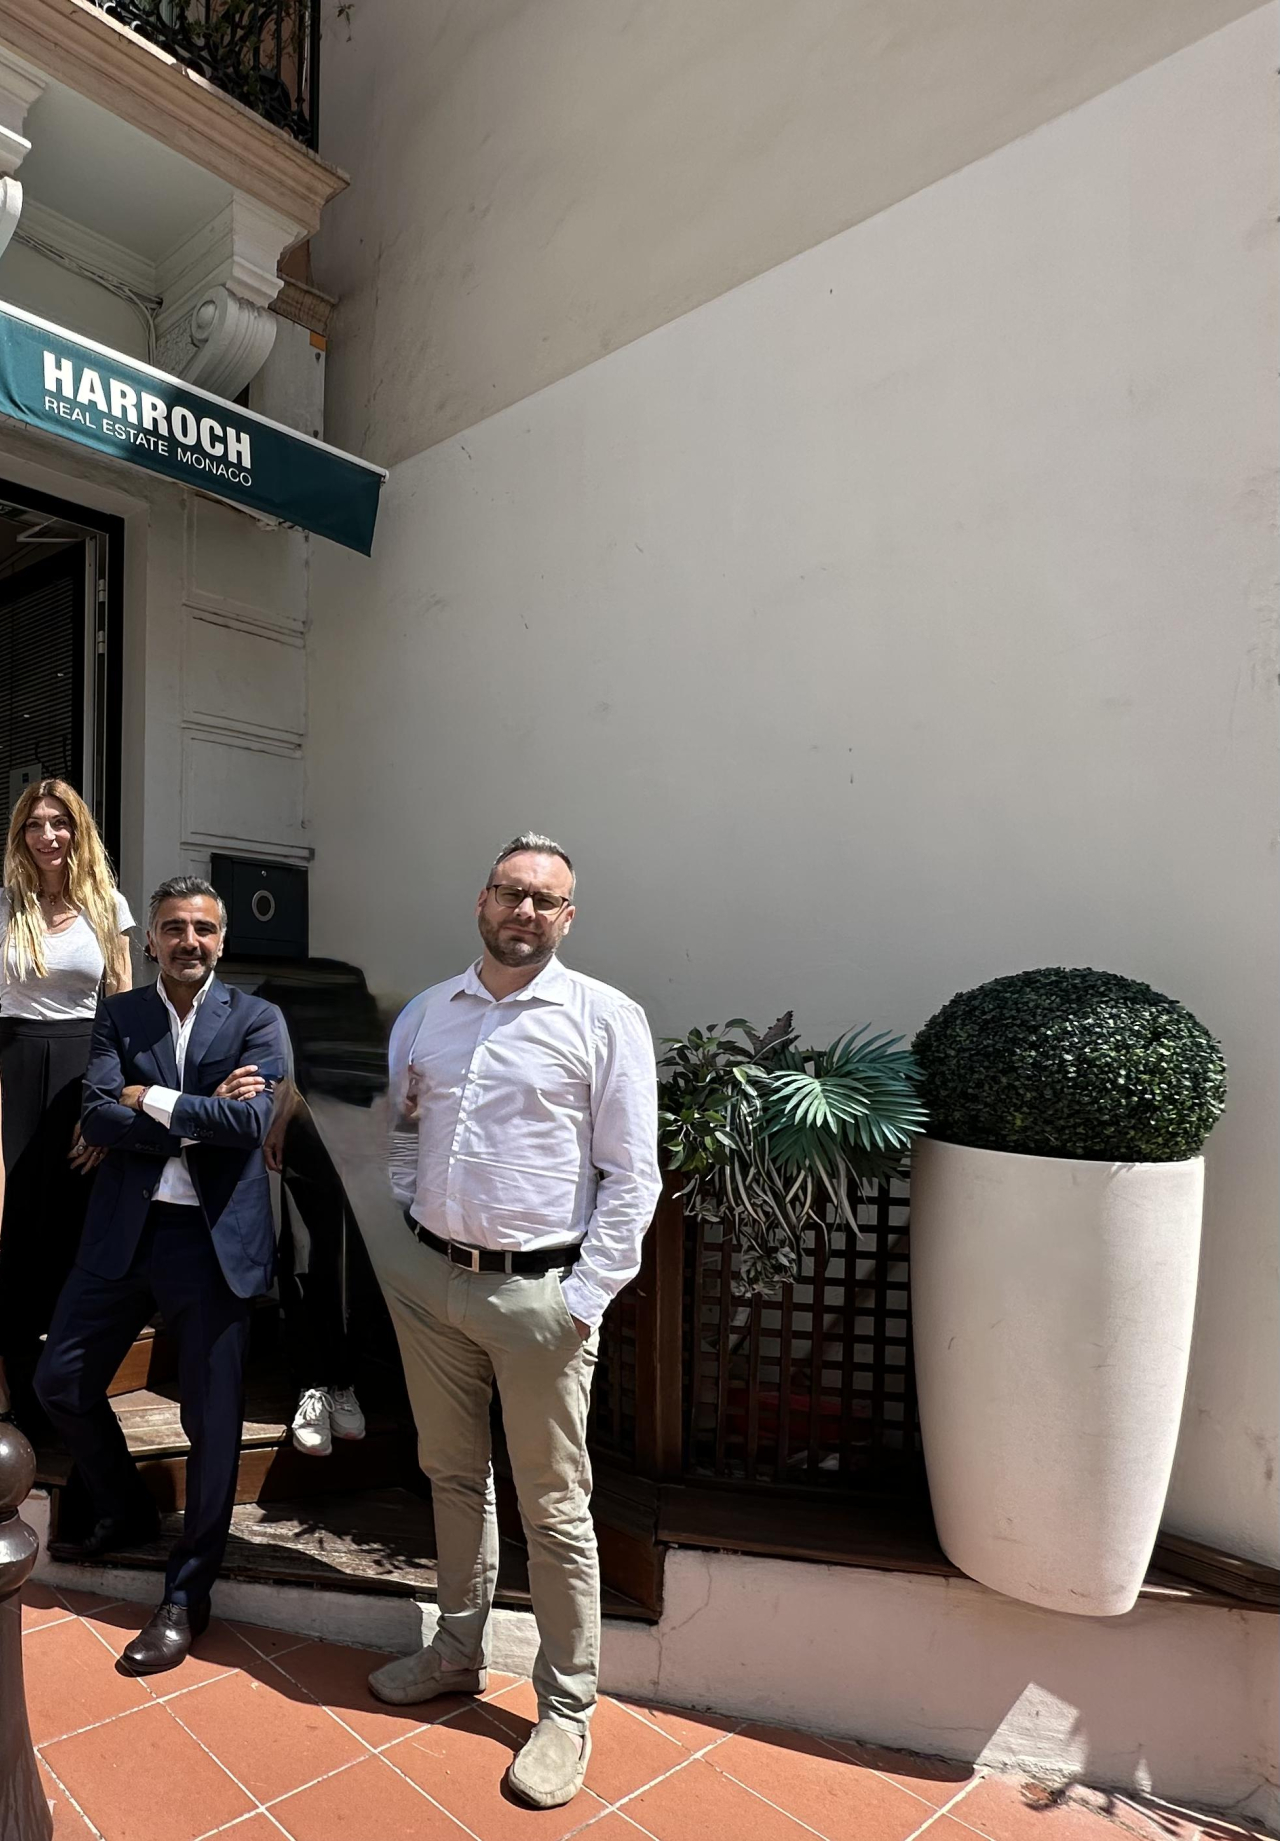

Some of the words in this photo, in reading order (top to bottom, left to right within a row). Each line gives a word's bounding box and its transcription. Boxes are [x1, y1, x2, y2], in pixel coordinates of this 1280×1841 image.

[43, 350, 252, 469] HARROCH
[44, 396, 97, 430] REAL
[102, 418, 169, 456] ESTATE
[177, 447, 252, 487] MONACO
